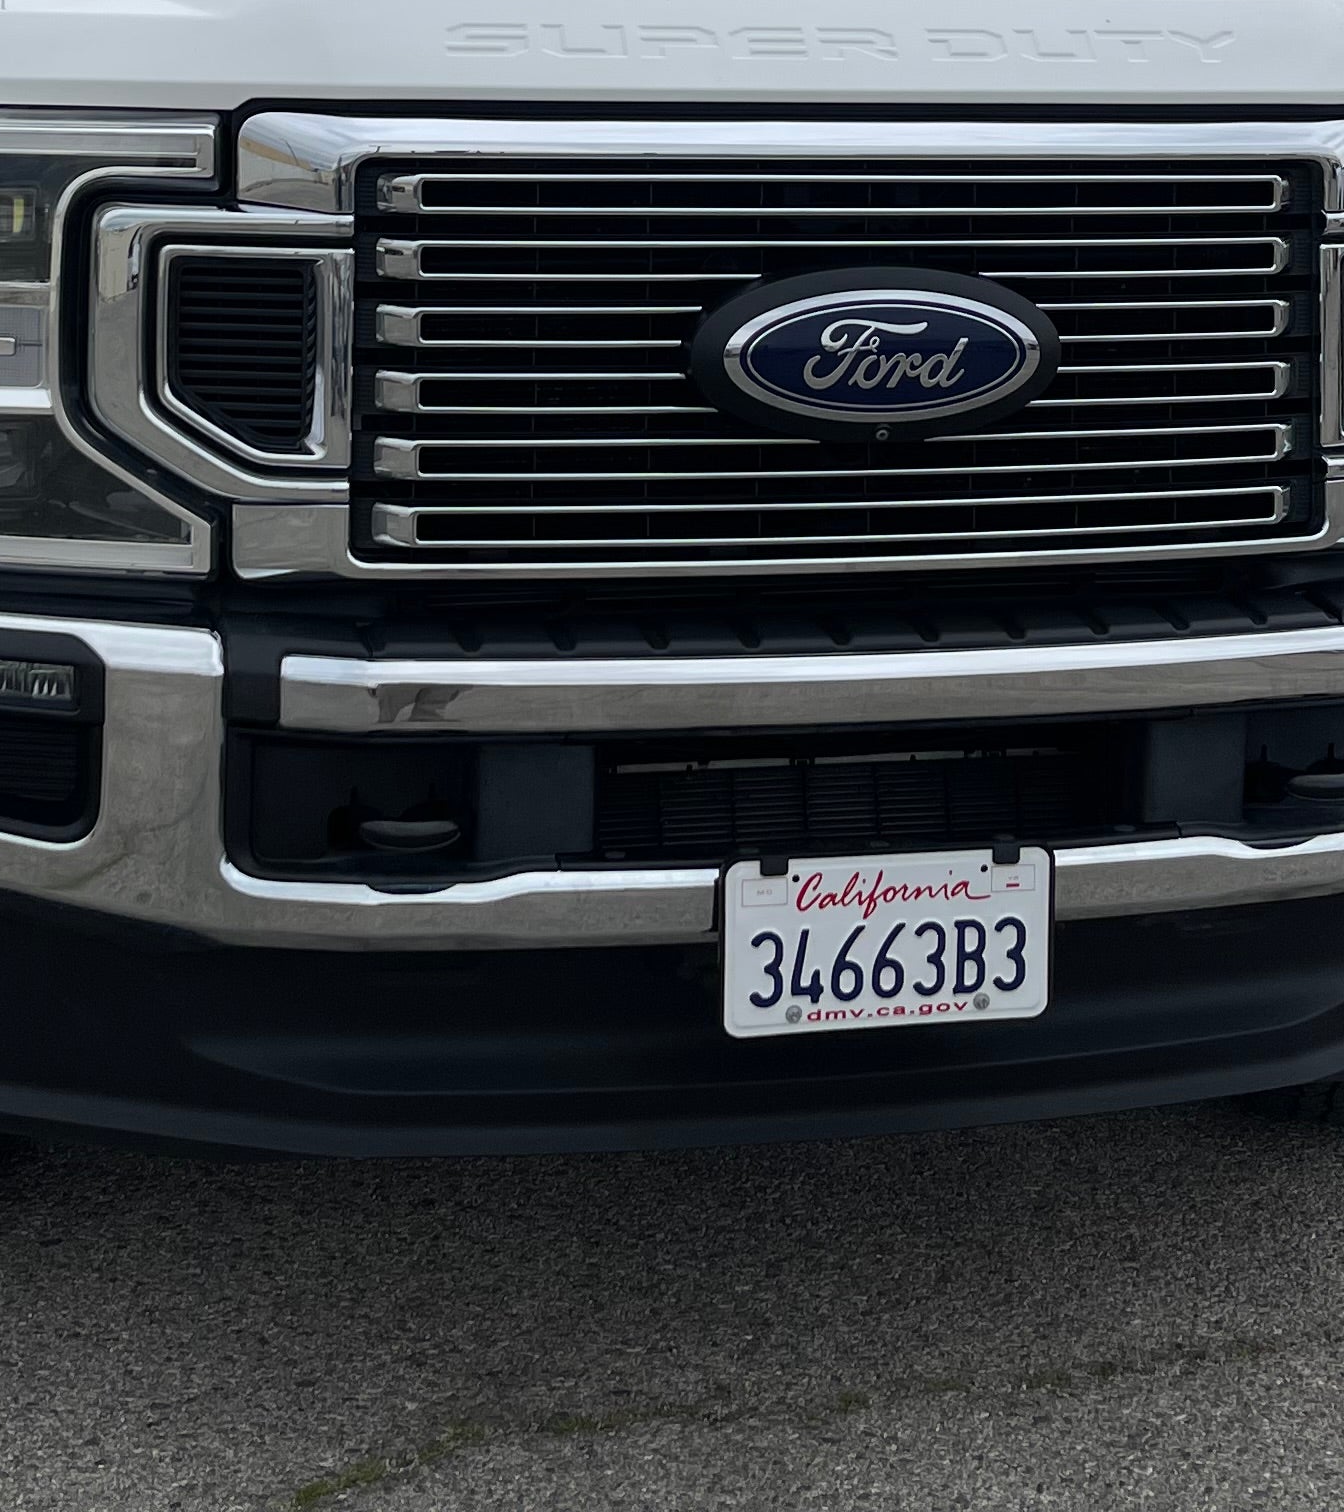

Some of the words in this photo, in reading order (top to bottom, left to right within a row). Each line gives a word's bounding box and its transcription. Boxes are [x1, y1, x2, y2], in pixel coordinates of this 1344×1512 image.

[445, 22, 899, 62] SUPER
[925, 28, 1237, 63] DUTY
[803, 318, 969, 390] Ford
[795, 869, 991, 920] California
[749, 916, 1027, 1008] 34663B3
[806, 999, 968, 1022] dmv.ca.gov
